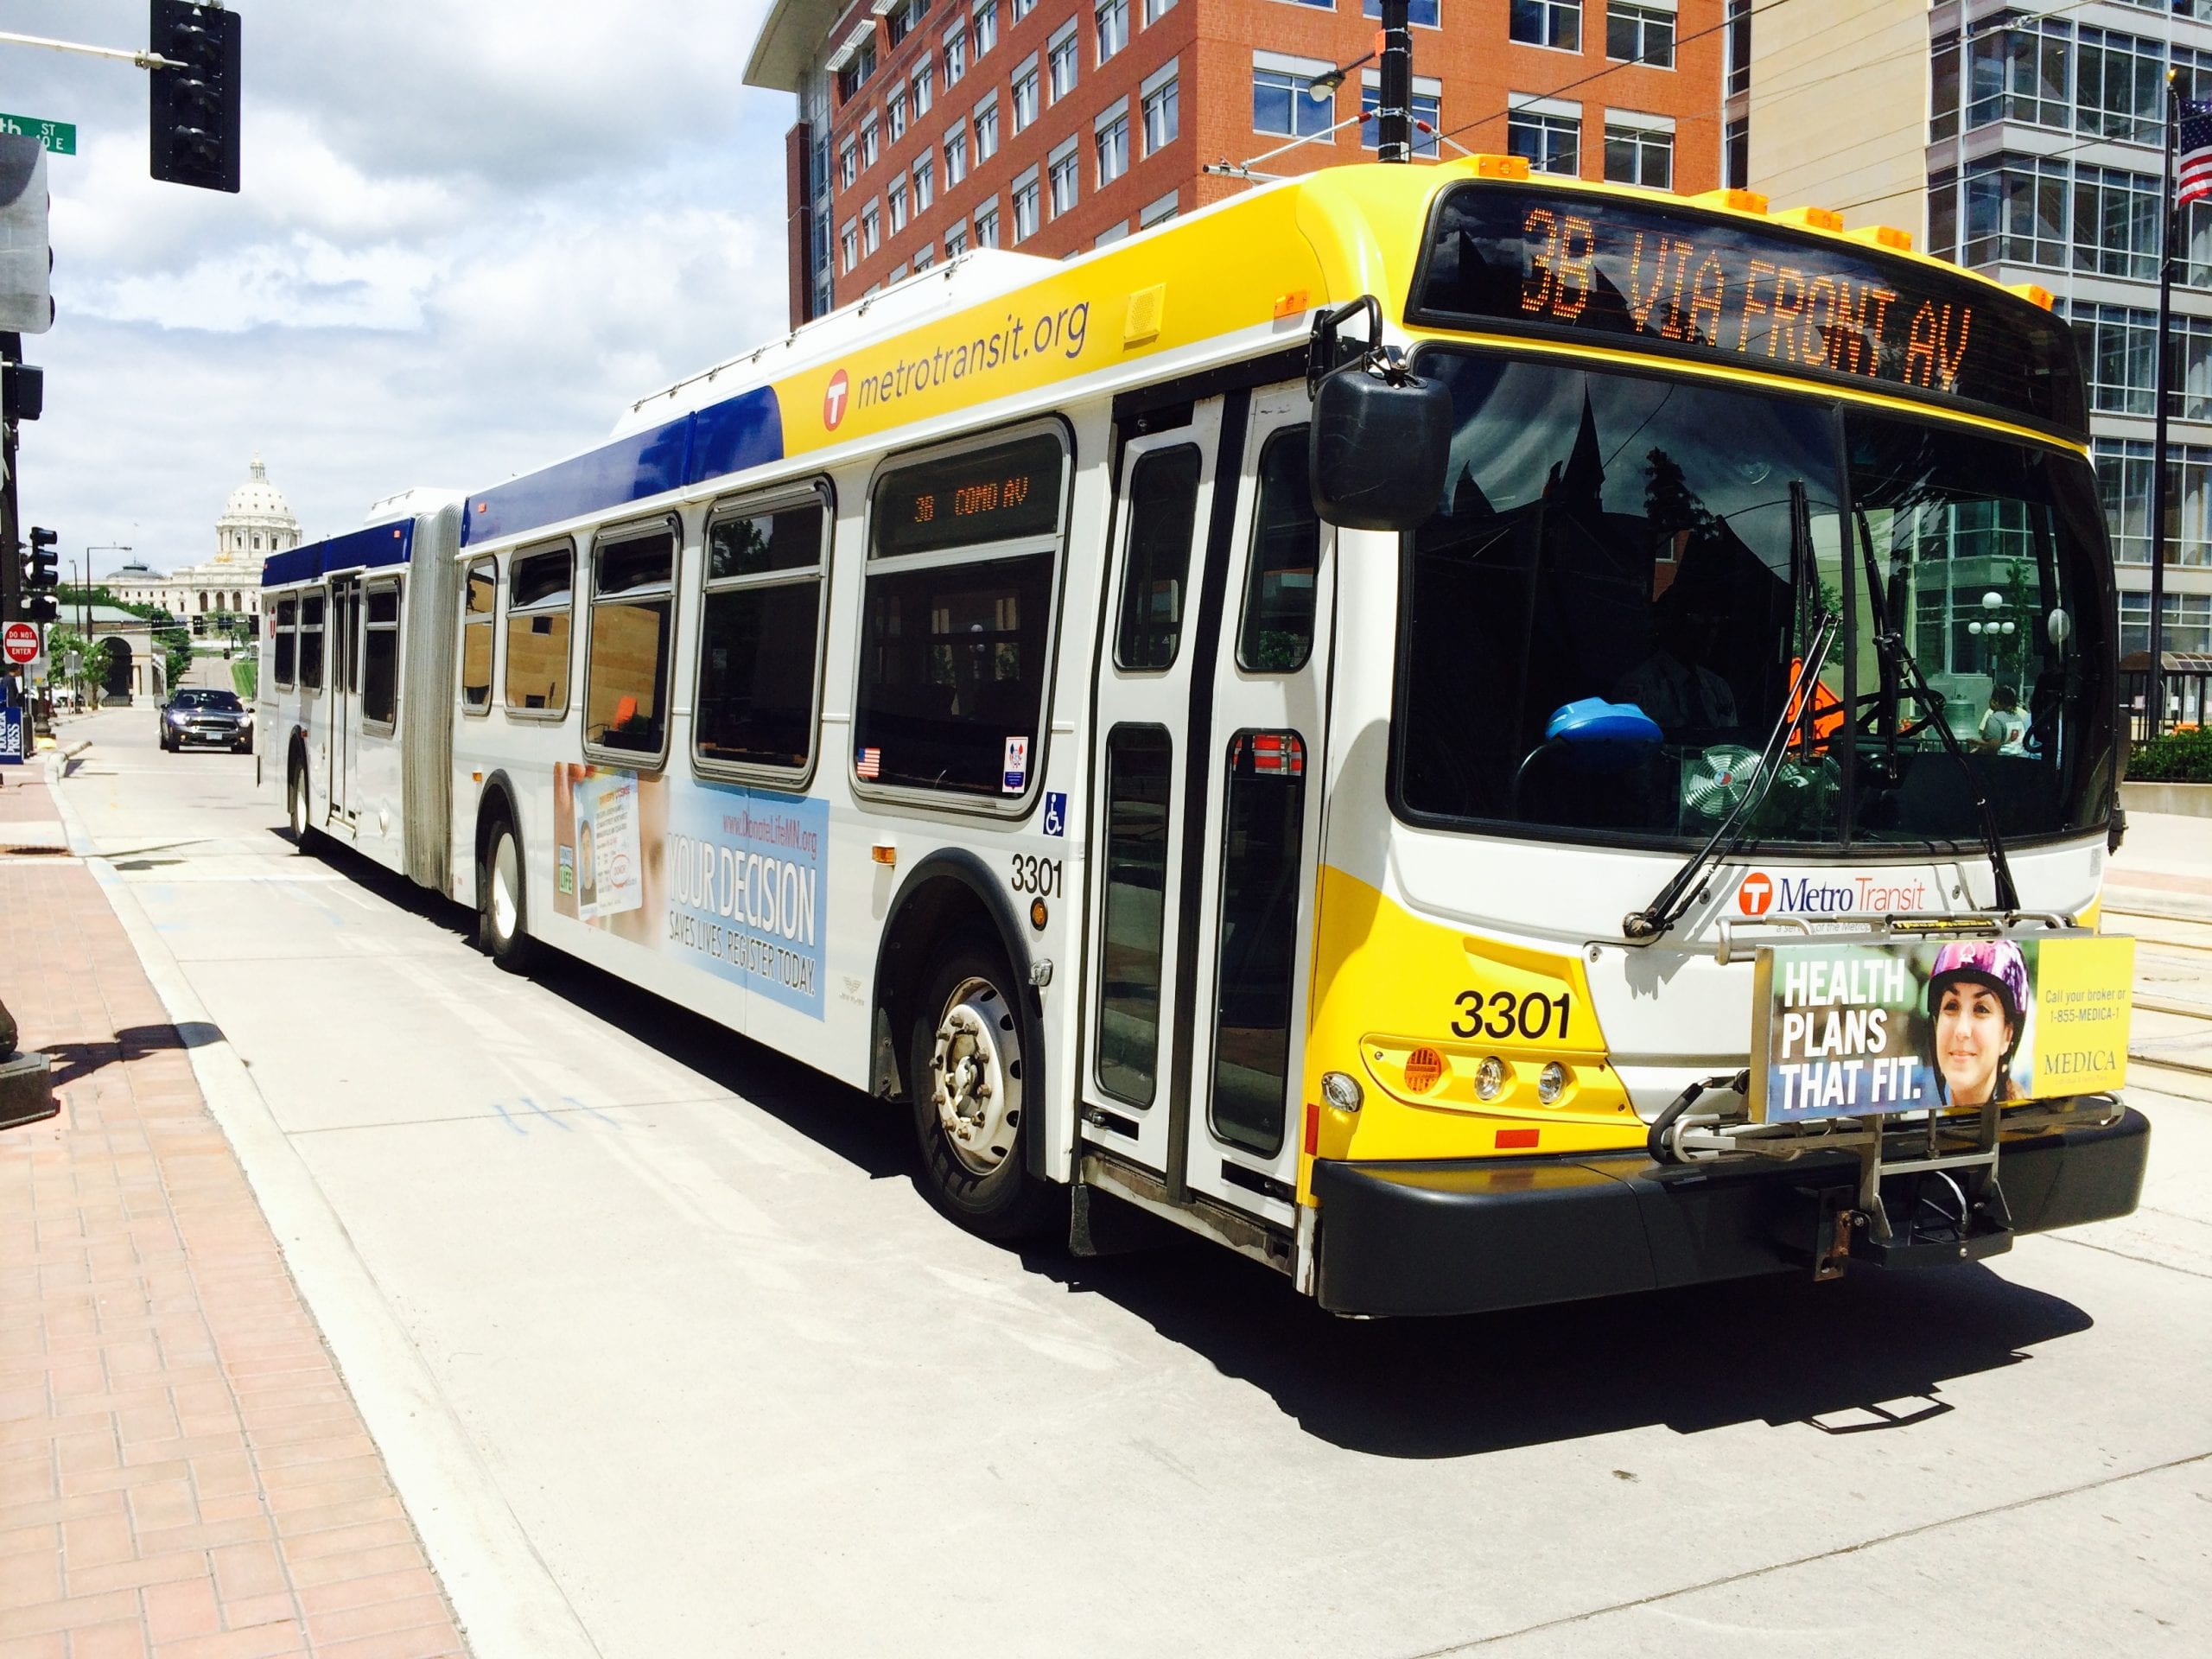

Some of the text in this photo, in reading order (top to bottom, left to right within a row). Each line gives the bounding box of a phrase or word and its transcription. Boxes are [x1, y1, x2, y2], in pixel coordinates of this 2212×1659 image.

[36, 135, 64, 150] 0 E
[41, 124, 55, 137] ST
[1522, 207, 1971, 392] 3B VIA FRONT AV
[858, 302, 1089, 410] metrotransit.org
[956, 483, 998, 516] COMO
[1003, 477, 1028, 507] AV
[11, 647, 32, 656] ENTER
[21, 631, 33, 639] NOT
[7, 723, 21, 756] PRESS
[723, 810, 817, 861] www.DonateLifeMN.org
[560, 870, 571, 891] LIFE
[667, 832, 716, 914] YOUR
[720, 846, 817, 947] DECISION
[1011, 853, 1062, 899] 3301
[1777, 878, 1853, 912] Metro
[1855, 877, 1926, 912] Transit
[1827, 922, 1840, 932] the
[669, 910, 816, 996] SAVES LIVES. REGISTER TODAY.
[1784, 958, 1905, 1007] HEALTH
[2045, 988, 2126, 1006] Call your broker or
[1451, 990, 1570, 1039] 3301
[2050, 1007, 2120, 1023] 1-855-MEDICA-1
[1782, 1008, 1888, 1059] PLANS
[2044, 1050, 2116, 1076] MEDICA
[1779, 1056, 1922, 1110] THAT FIT.
